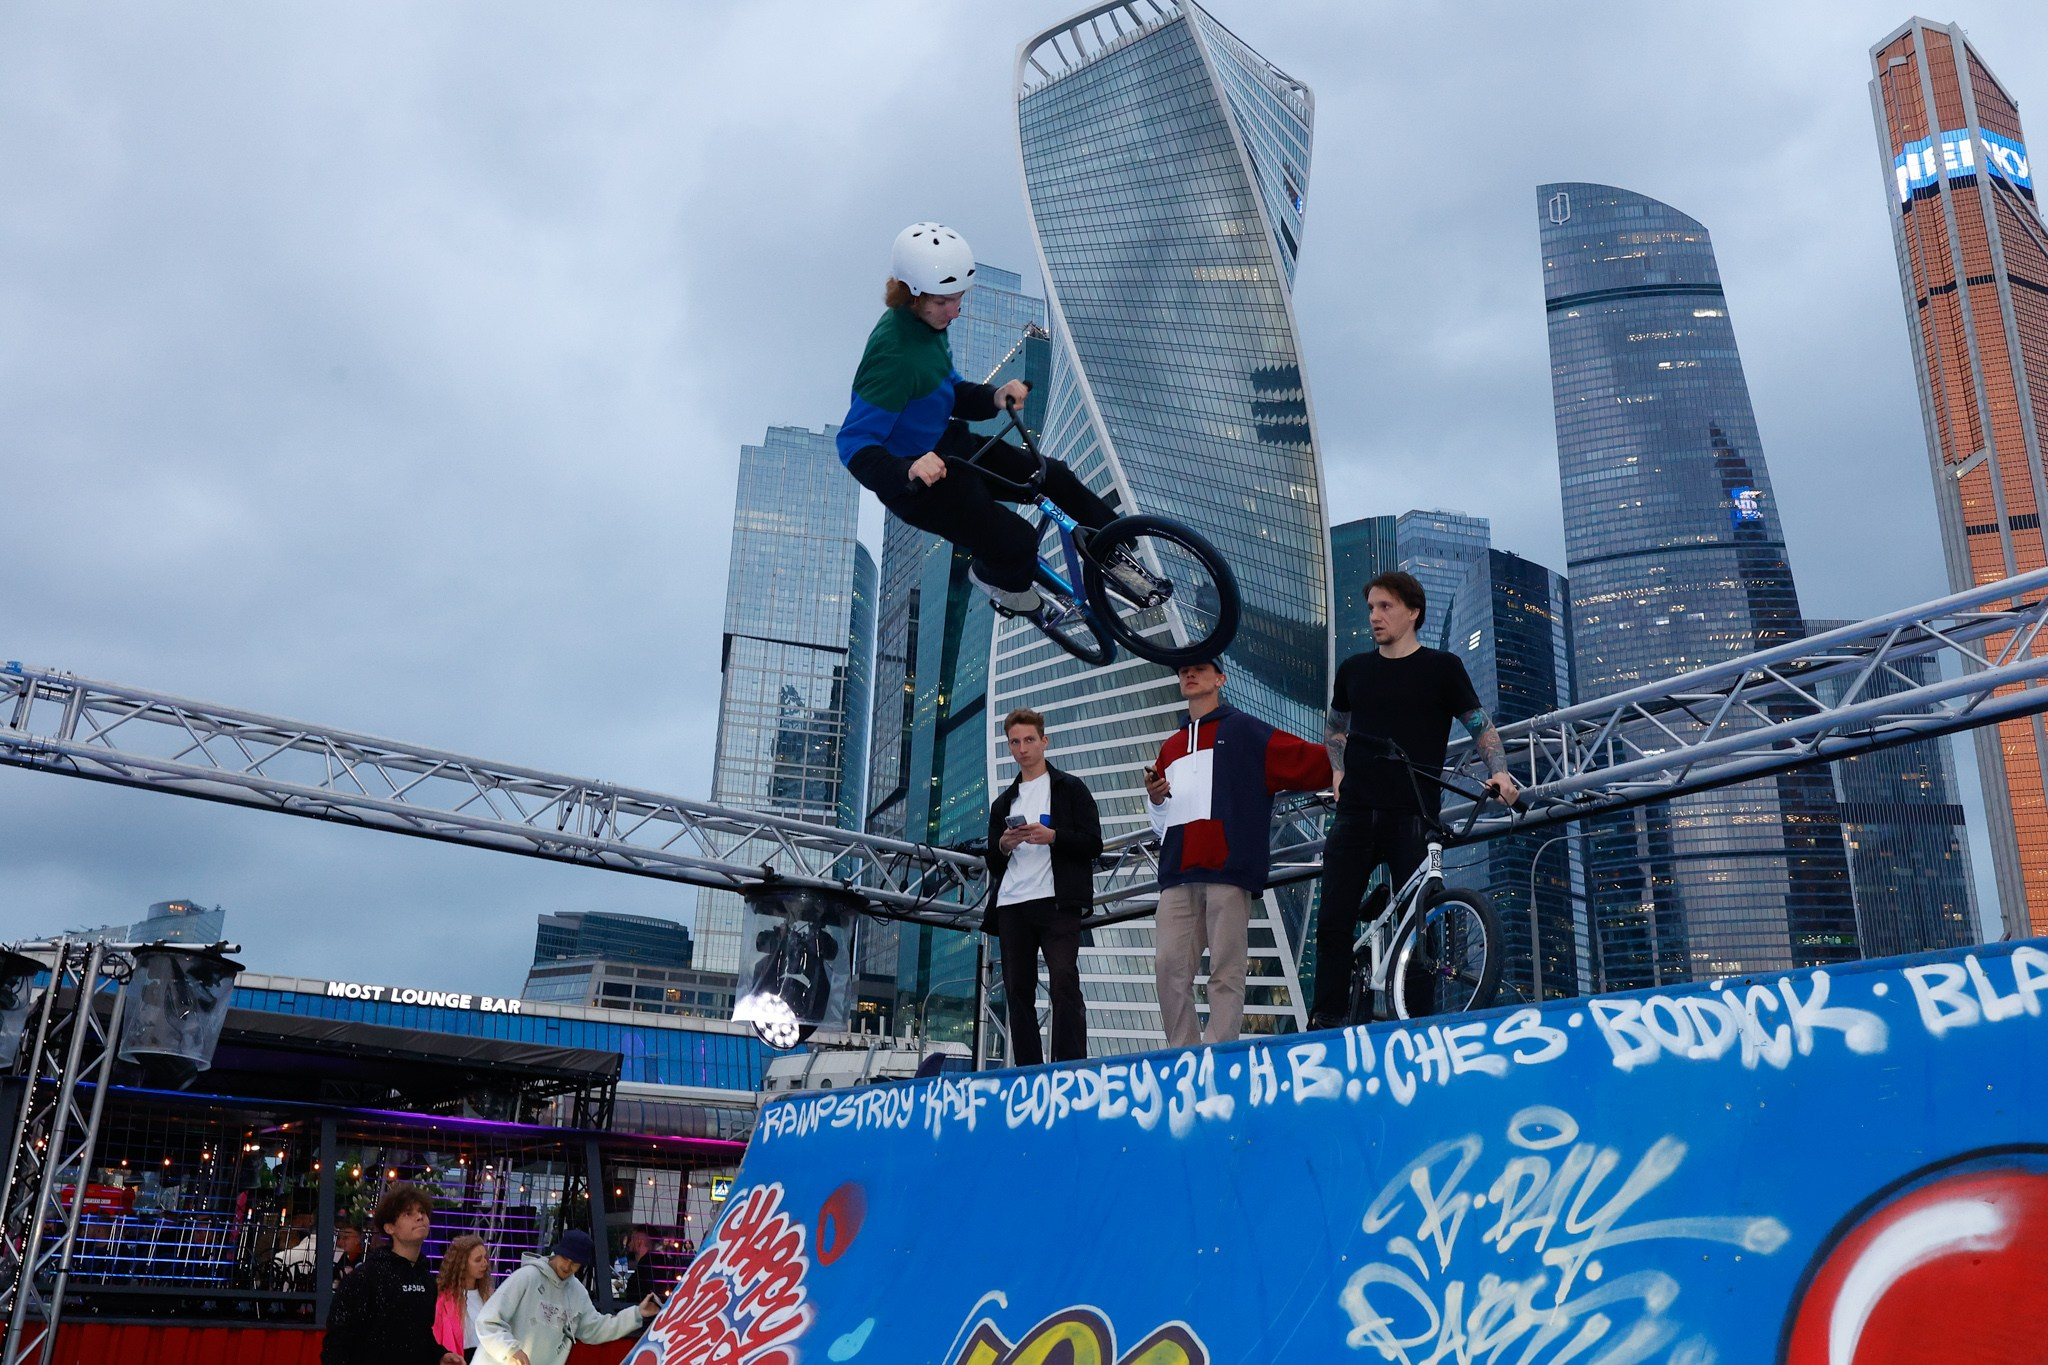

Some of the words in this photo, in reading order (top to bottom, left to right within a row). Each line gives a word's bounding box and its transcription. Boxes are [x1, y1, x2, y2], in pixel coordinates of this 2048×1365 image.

[326, 981, 385, 1001] MOST
[390, 987, 472, 1010] LOUNGE
[479, 996, 522, 1015] BAR
